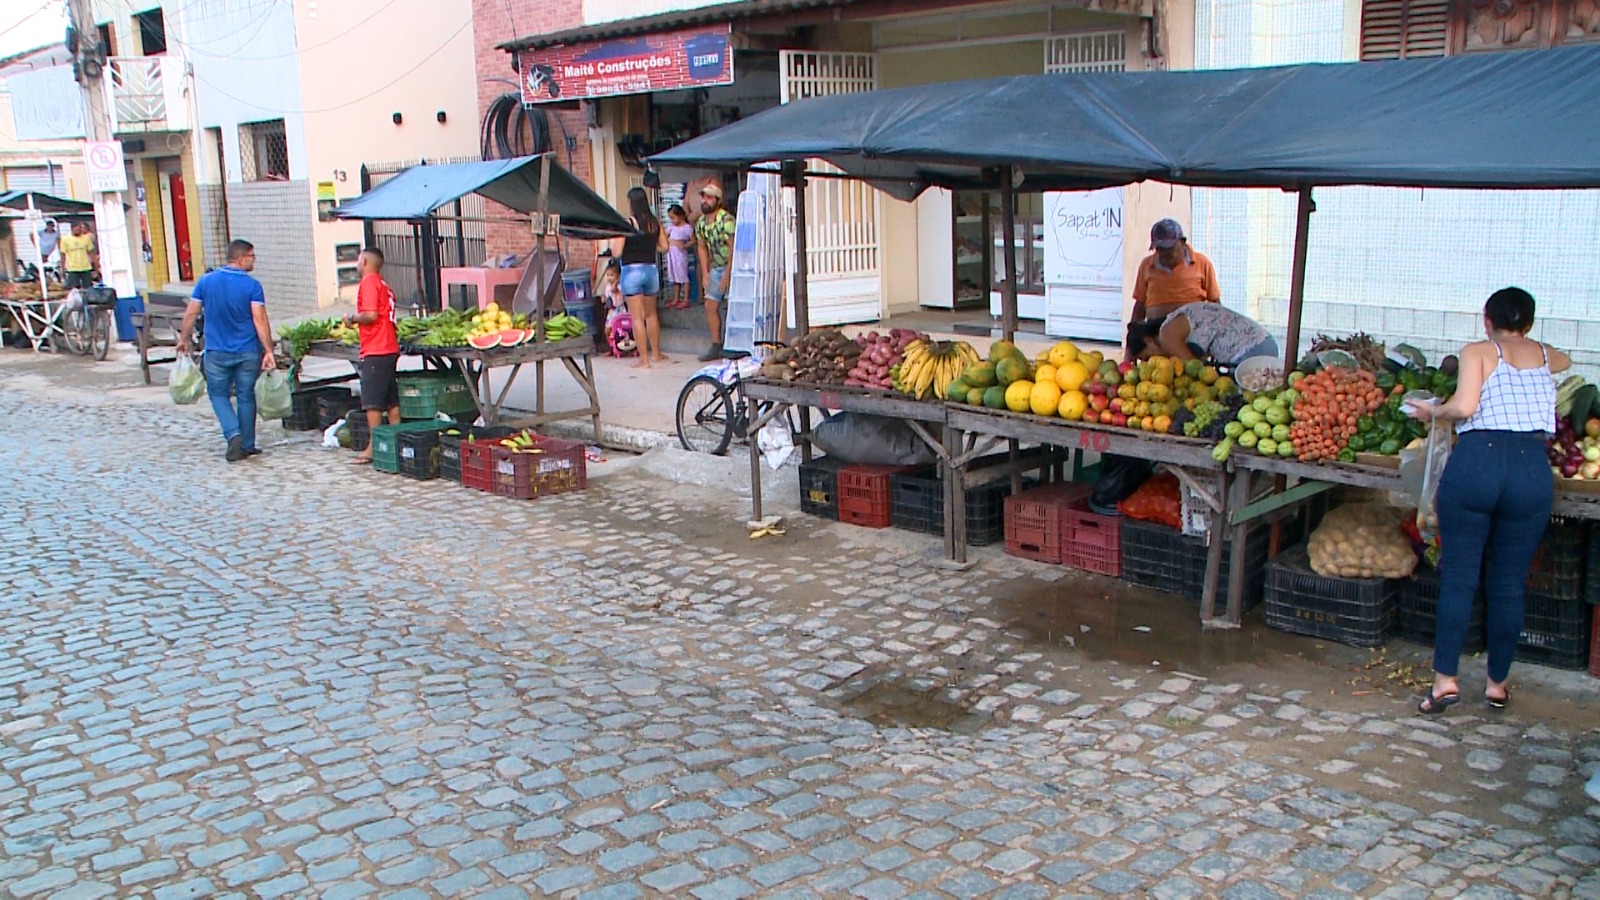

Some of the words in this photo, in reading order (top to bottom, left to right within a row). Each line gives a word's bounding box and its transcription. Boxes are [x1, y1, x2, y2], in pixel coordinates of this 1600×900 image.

[564, 63, 595, 78] Maitê
[597, 55, 672, 74] Construções
[333, 169, 347, 182] 13
[98, 180, 119, 188] TAXI
